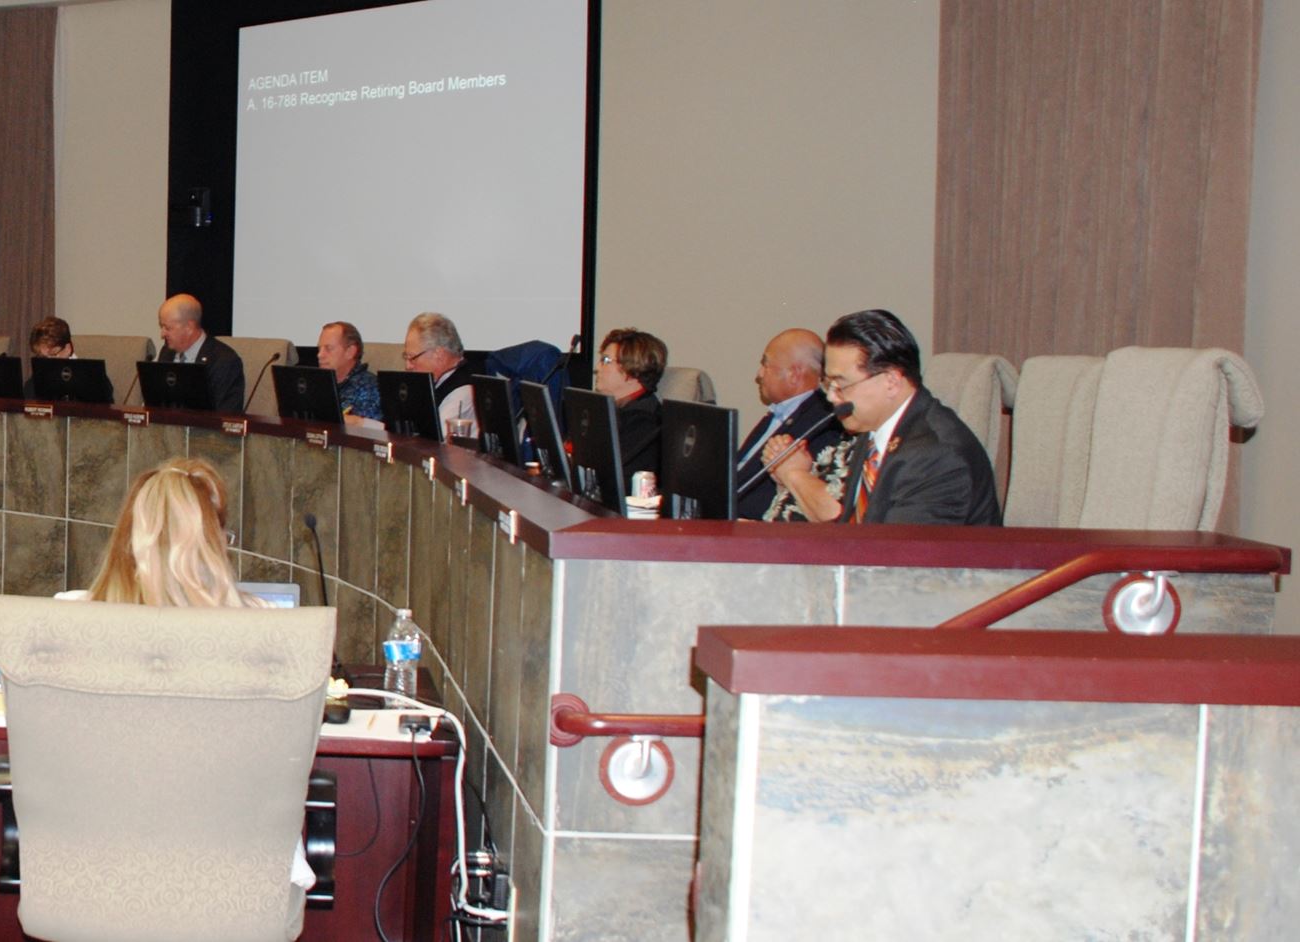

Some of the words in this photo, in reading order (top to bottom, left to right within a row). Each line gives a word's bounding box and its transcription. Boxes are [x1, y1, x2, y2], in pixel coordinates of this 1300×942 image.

[248, 73, 298, 91] AGENDA
[300, 69, 329, 85] ITEM
[300, 90, 358, 107] Recognize
[360, 84, 405, 99] Retiring
[408, 78, 444, 95] Board
[447, 73, 507, 91] Members
